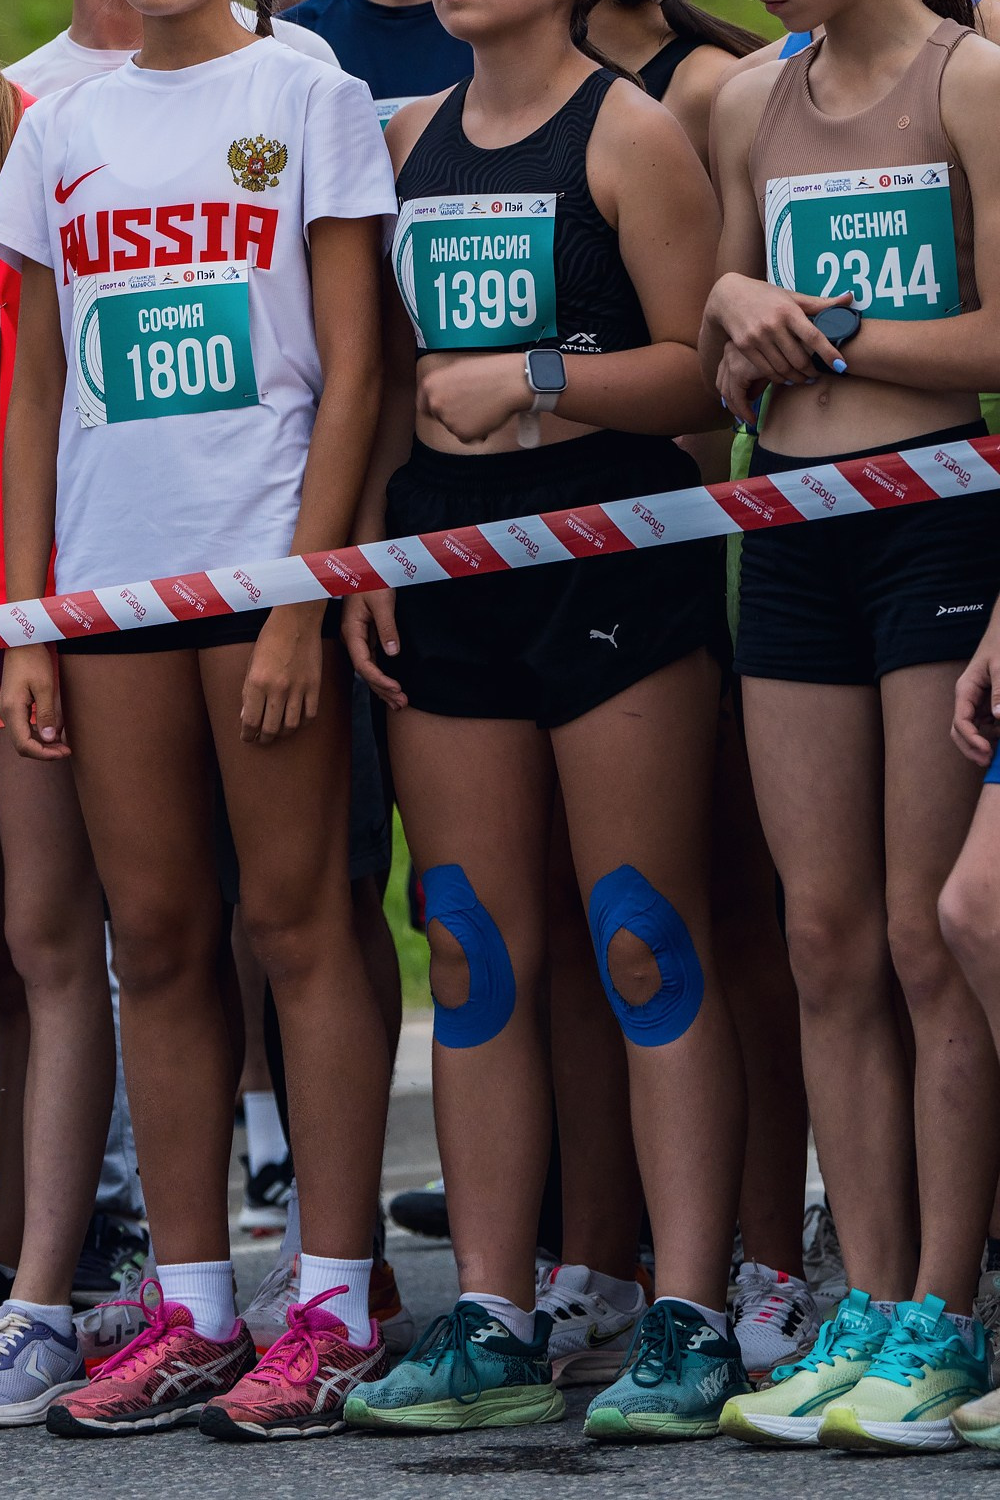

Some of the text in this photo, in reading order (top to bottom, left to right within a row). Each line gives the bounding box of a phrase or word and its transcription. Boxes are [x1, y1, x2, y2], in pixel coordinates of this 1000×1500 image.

[894, 174, 913, 185] Пэй
[505, 202, 523, 212] Пэй
[830, 210, 908, 241] КСЕНИЯ
[59, 202, 279, 286] RUSSIA
[430, 235, 530, 262] АНАСТАСИЯ
[197, 270, 215, 280] Пэй
[816, 244, 940, 311] 2344
[434, 269, 537, 330] 1399
[138, 302, 204, 334] СОФИЯ
[560, 344, 602, 352] ATHLEX
[126, 334, 236, 400] 1800
[934, 453, 943, 462] 40
[943, 460, 971, 481] СПОРТ
[801, 476, 810, 486] 40
[862, 467, 904, 499] НЕ СНИМАТЬ!
[957, 478, 968, 488] PRO
[810, 483, 837, 504] СПОРТ
[632, 505, 641, 514] 40
[732, 490, 773, 521] НЕ СНИМАТЬ!
[822, 501, 833, 511] PRO
[508, 526, 516, 535] 40
[640, 511, 665, 533] СПОРТ
[515, 531, 539, 553] СПОРТ
[565, 518, 603, 549] НЕ СНИМАТЬ!
[652, 529, 662, 539] PRO
[387, 545, 395, 555] 40
[443, 539, 479, 569] НЕ СНИМАТЬ!
[394, 553, 417, 573] СПОРТ
[233, 571, 261, 597] СПОРТ 40
[350, 579, 359, 588] НЕ
[120, 590, 146, 616] СПОРТ 40
[196, 603, 204, 612] НЕ
[947, 604, 984, 614] DEMIX
[16, 613, 35, 633] СПОРТ
[83, 620, 91, 630] НЕ
[696, 1362, 729, 1404] HOKA
